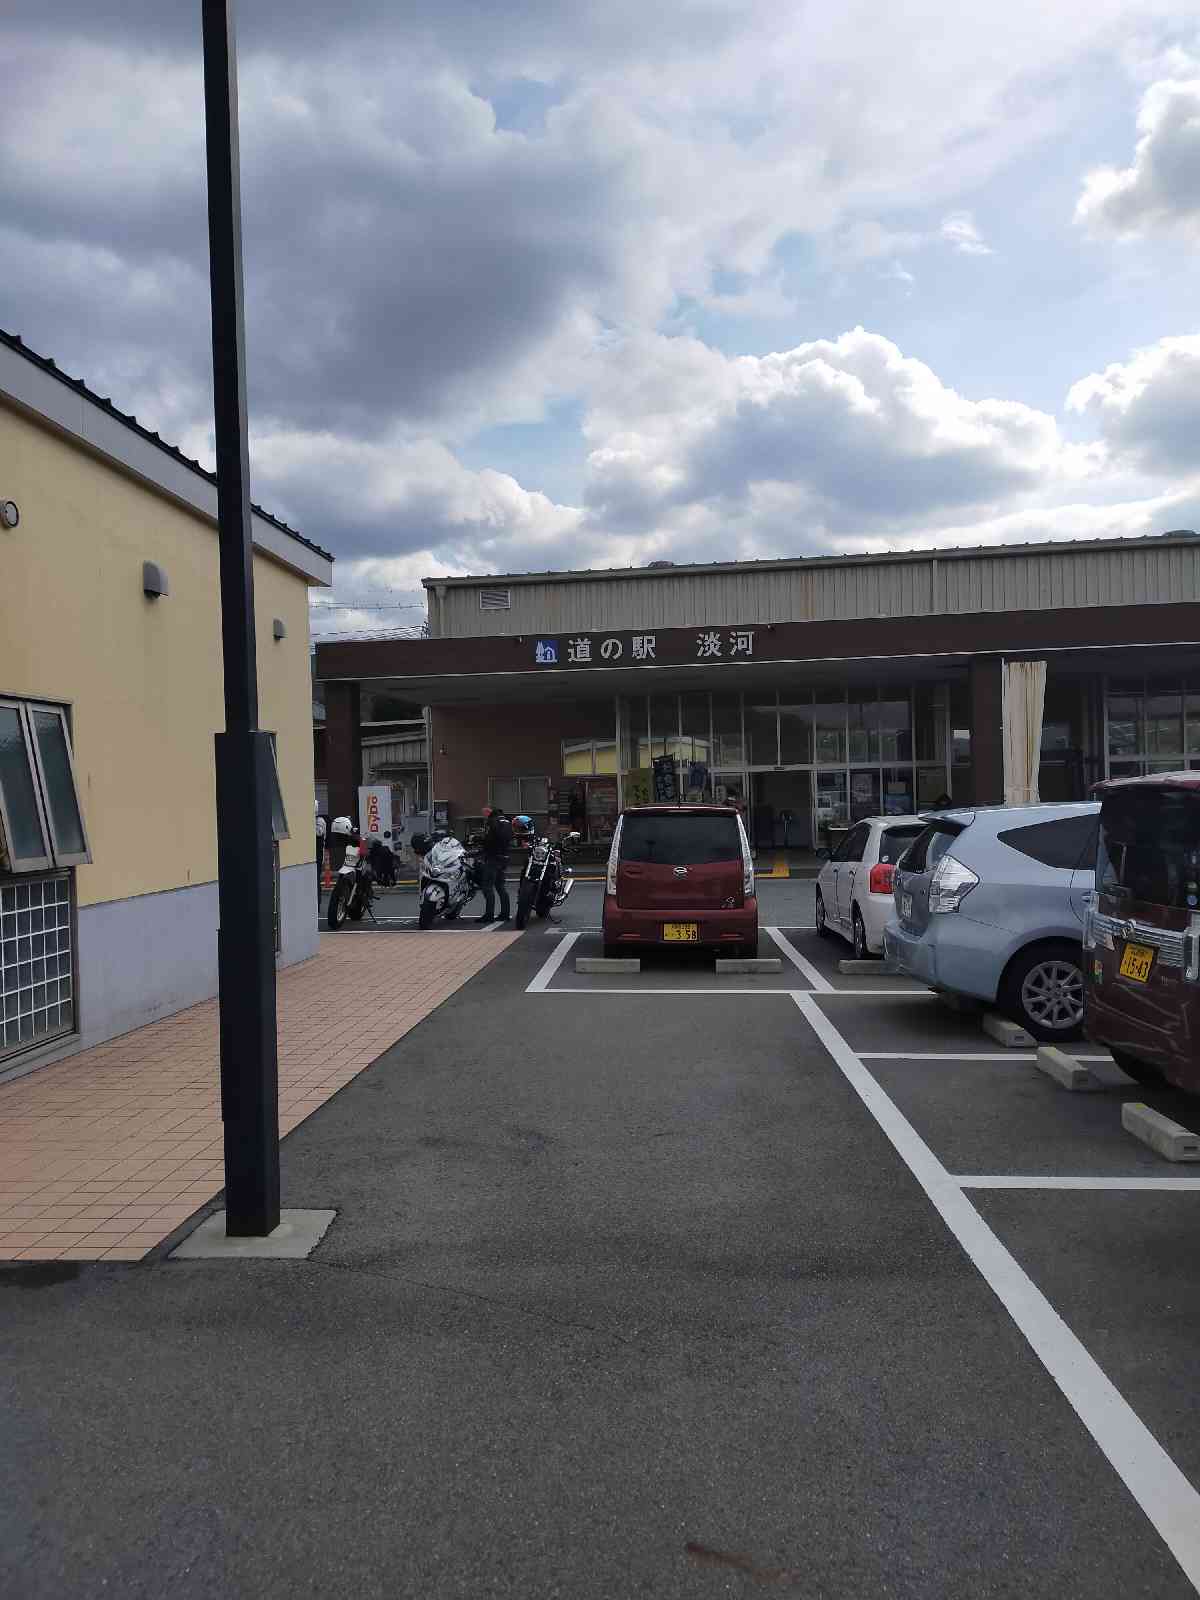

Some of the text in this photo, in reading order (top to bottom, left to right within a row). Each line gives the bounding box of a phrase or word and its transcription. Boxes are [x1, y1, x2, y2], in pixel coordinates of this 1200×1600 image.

[567, 631, 754, 662] 道の駅 淡河
[368, 796, 380, 833] DyDo
